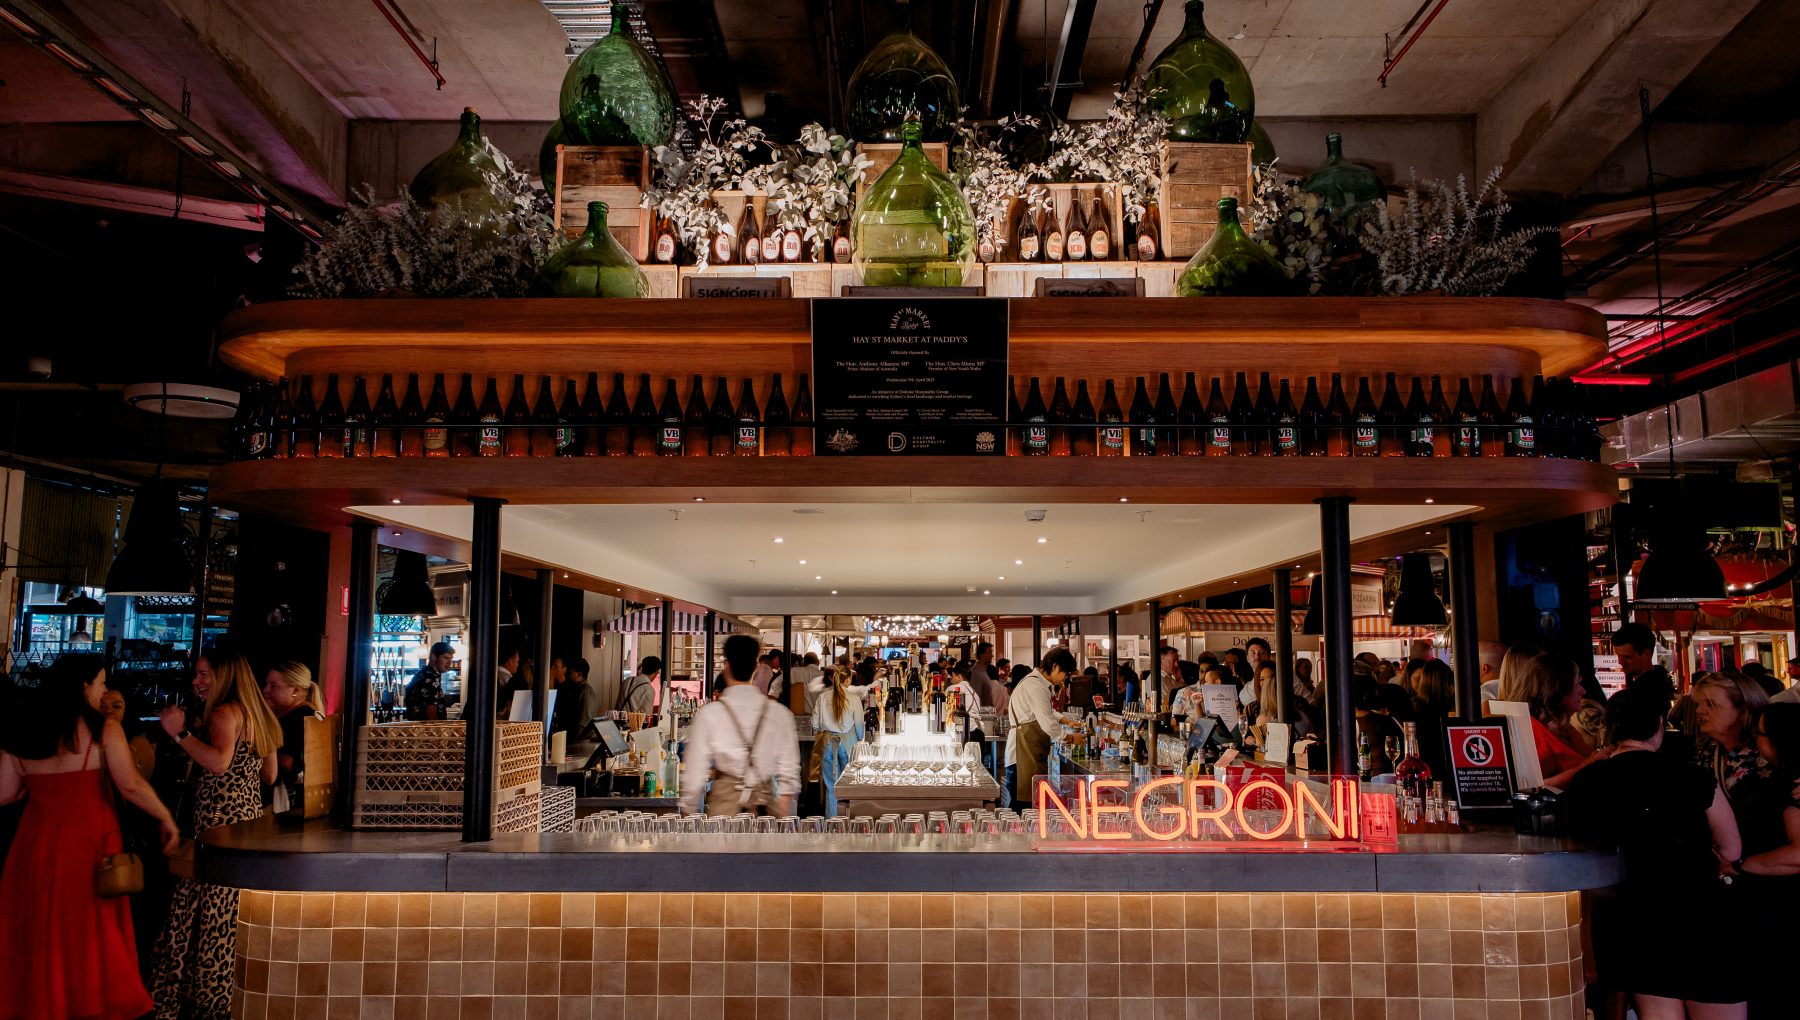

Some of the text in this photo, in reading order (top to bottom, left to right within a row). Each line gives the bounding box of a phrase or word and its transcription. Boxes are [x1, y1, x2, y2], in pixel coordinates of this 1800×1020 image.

[889, 312, 900, 329] HAY
[905, 307, 931, 329] MARKET
[853, 336, 968, 344] HAY ST MARKET AT PADDY'S
[665, 429, 679, 437] VB
[1032, 428, 1044, 436] VB
[1109, 429, 1121, 437] VB
[1280, 429, 1291, 437] VB
[1521, 428, 1533, 436] VB
[976, 442, 995, 450] NSW
[1037, 776, 1359, 840] NEGRONI
